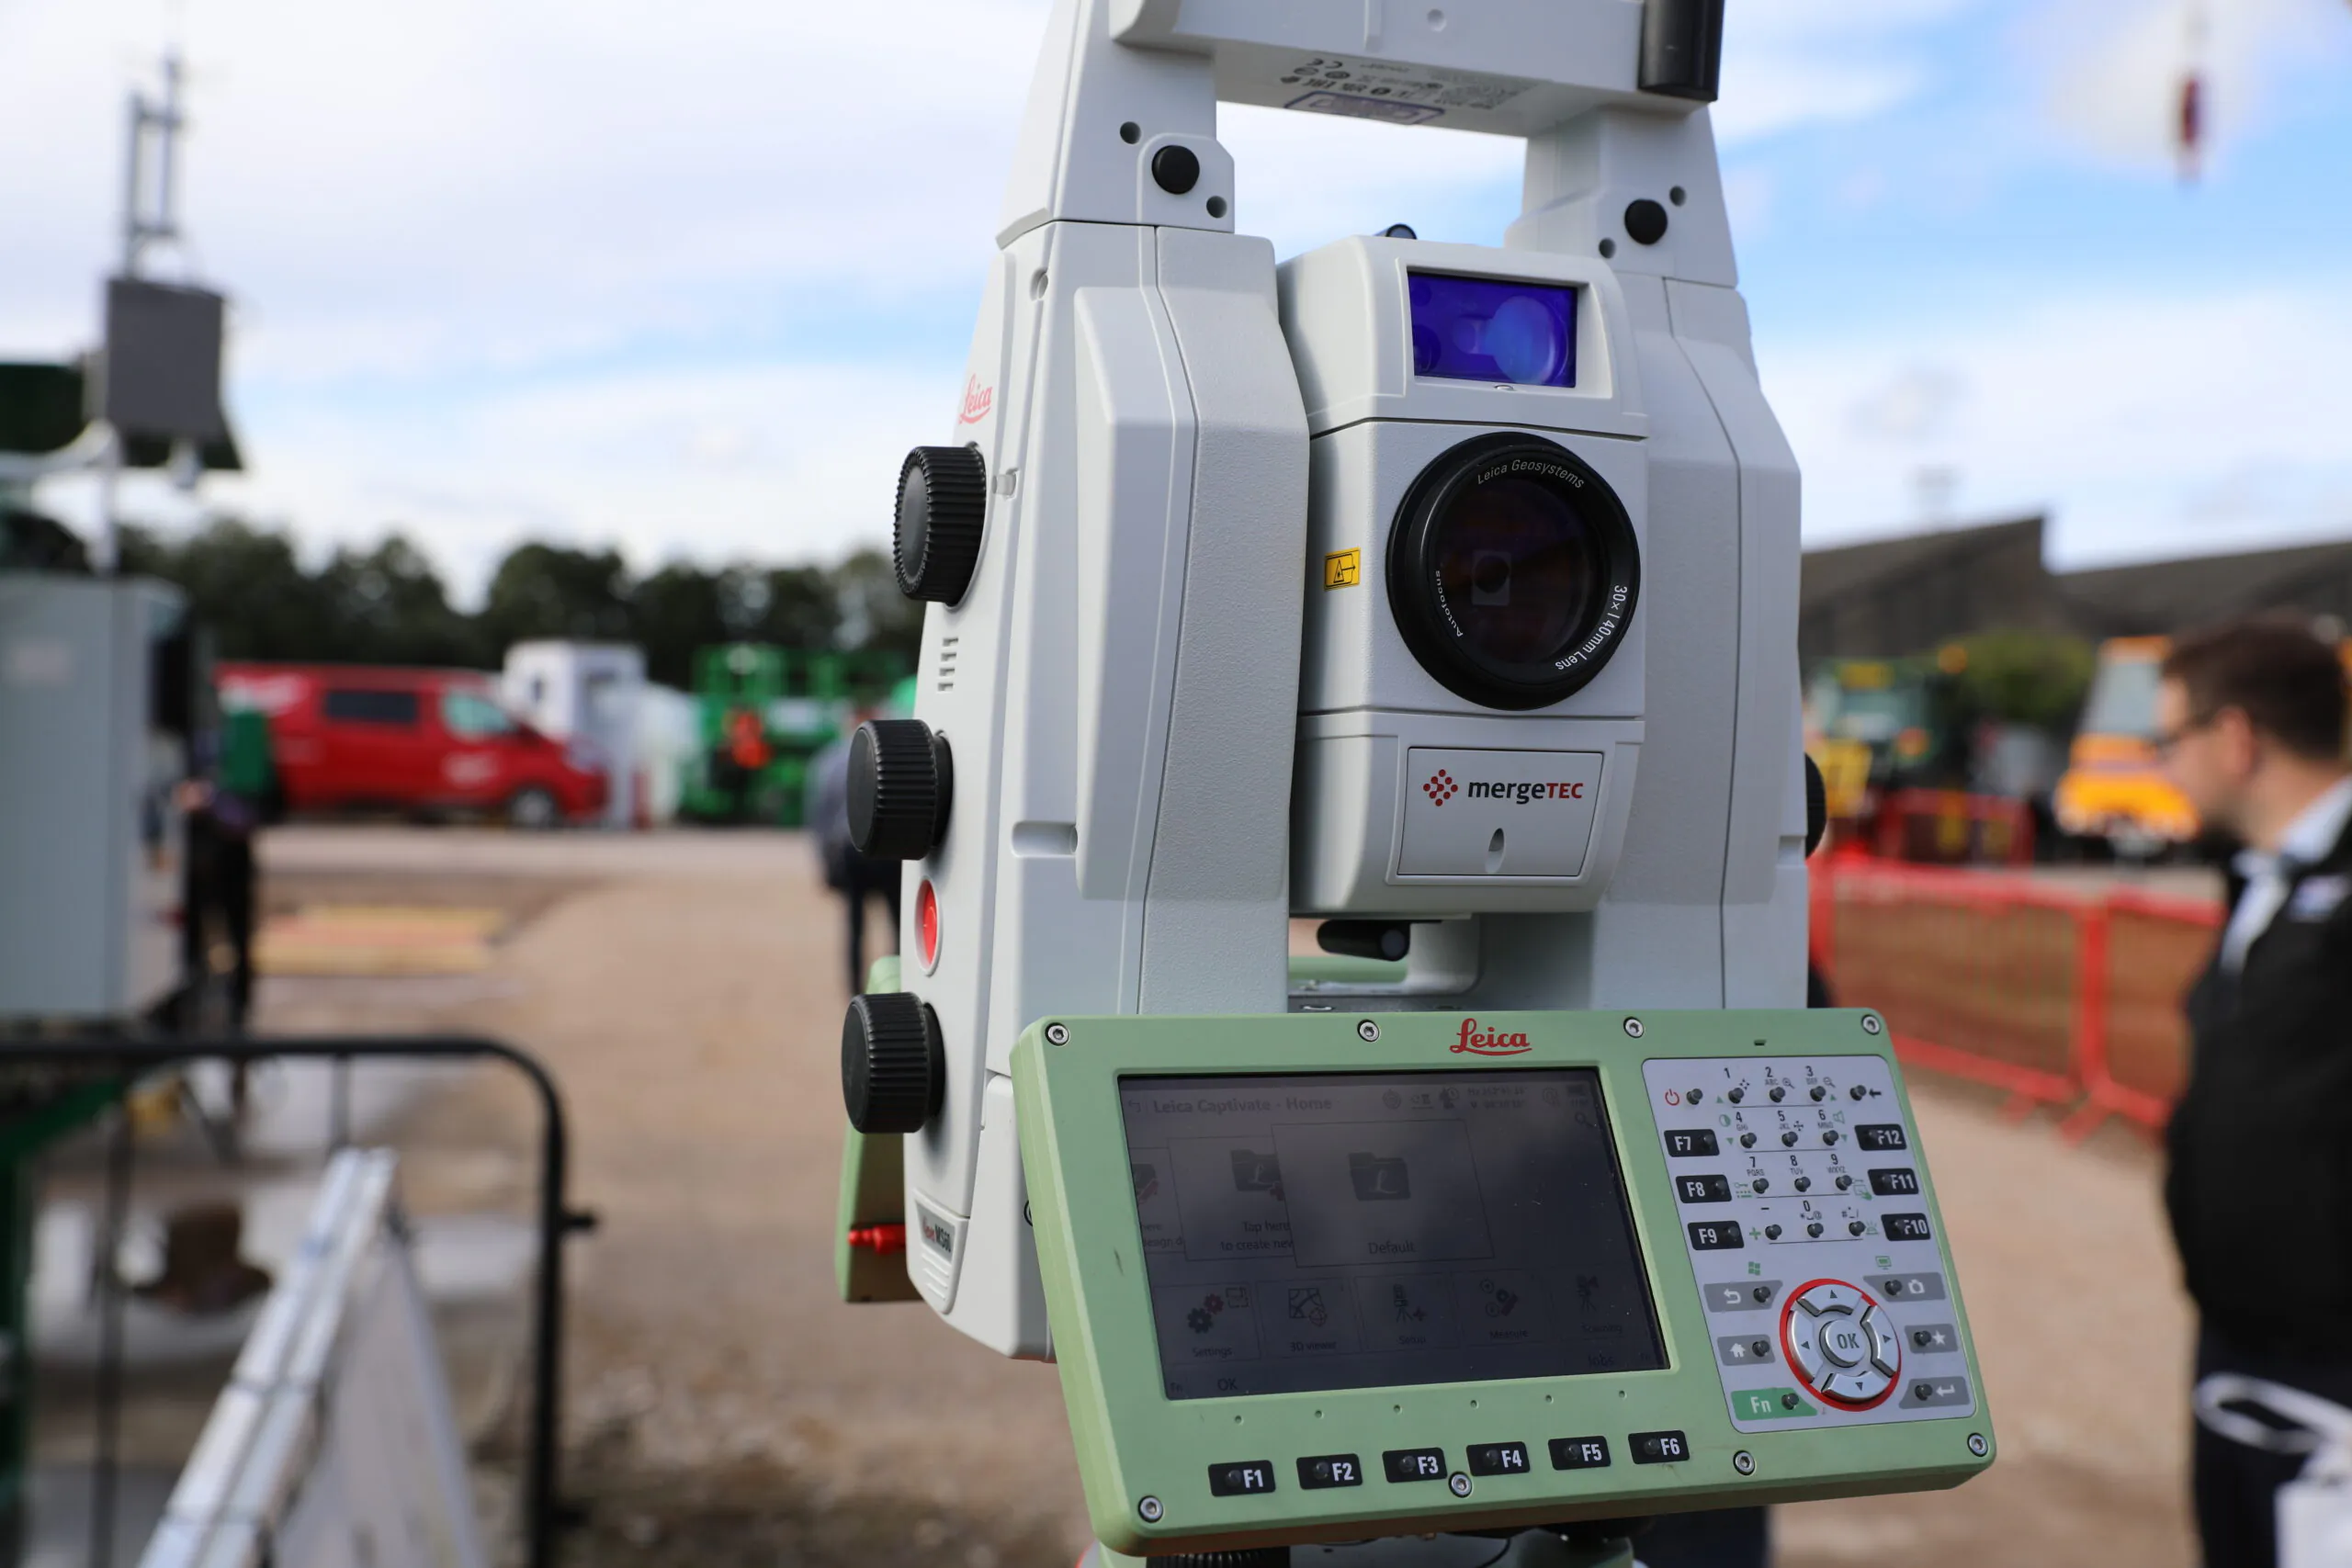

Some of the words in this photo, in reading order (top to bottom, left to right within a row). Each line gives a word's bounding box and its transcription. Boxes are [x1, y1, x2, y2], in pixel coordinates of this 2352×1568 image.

[958, 373, 993, 424] Leica
[1477, 464, 1508, 485] Leica
[1511, 459, 1585, 489] Geosystems
[1435, 570, 1464, 637] Autofocus
[1611, 584, 1628, 611] 30x
[1583, 619, 1616, 654] 40mm
[1555, 650, 1588, 671] Lens
[1468, 781, 1584, 805] mergeTEC
[1449, 1018, 1532, 1056] Leica
[1724, 1066, 1731, 1078] 1
[1765, 1066, 1774, 1077] 2
[1804, 1066, 1814, 1077] 3
[1153, 1099, 1193, 1113] Leica
[1197, 1098, 1271, 1116] Captivate
[1286, 1096, 1332, 1111] Home
[1735, 1111, 1743, 1122] 4
[1777, 1110, 1786, 1122] 5
[1817, 1109, 1826, 1121] 6
[1674, 1135, 1691, 1151] F7
[1876, 1129, 1903, 1145] F12
[1748, 1156, 1756, 1168] 7
[1790, 1155, 1798, 1167] 8
[1830, 1154, 1838, 1165] 9
[1747, 1168, 1765, 1177] PQRS
[1686, 1181, 1706, 1197] F8
[1889, 1174, 1915, 1190] F11
[1803, 1200, 1811, 1212] 0
[1242, 1221, 1262, 1235] Tap
[1903, 1219, 1928, 1235] F10
[1698, 1228, 1718, 1244] F9
[1220, 1240, 1234, 1251] to
[1368, 1238, 1417, 1255] Default
[1289, 1341, 1304, 1352] 3D
[1836, 1333, 1860, 1349] OK
[1216, 1377, 1239, 1392] OK
[1750, 1395, 1772, 1414] Fn
[1581, 1443, 1603, 1462] F5
[1659, 1437, 1681, 1456] F6
[1418, 1456, 1440, 1475] F3
[1501, 1450, 1522, 1468] F4
[1242, 1470, 1264, 1488] F1
[1332, 1462, 1355, 1482] F2
